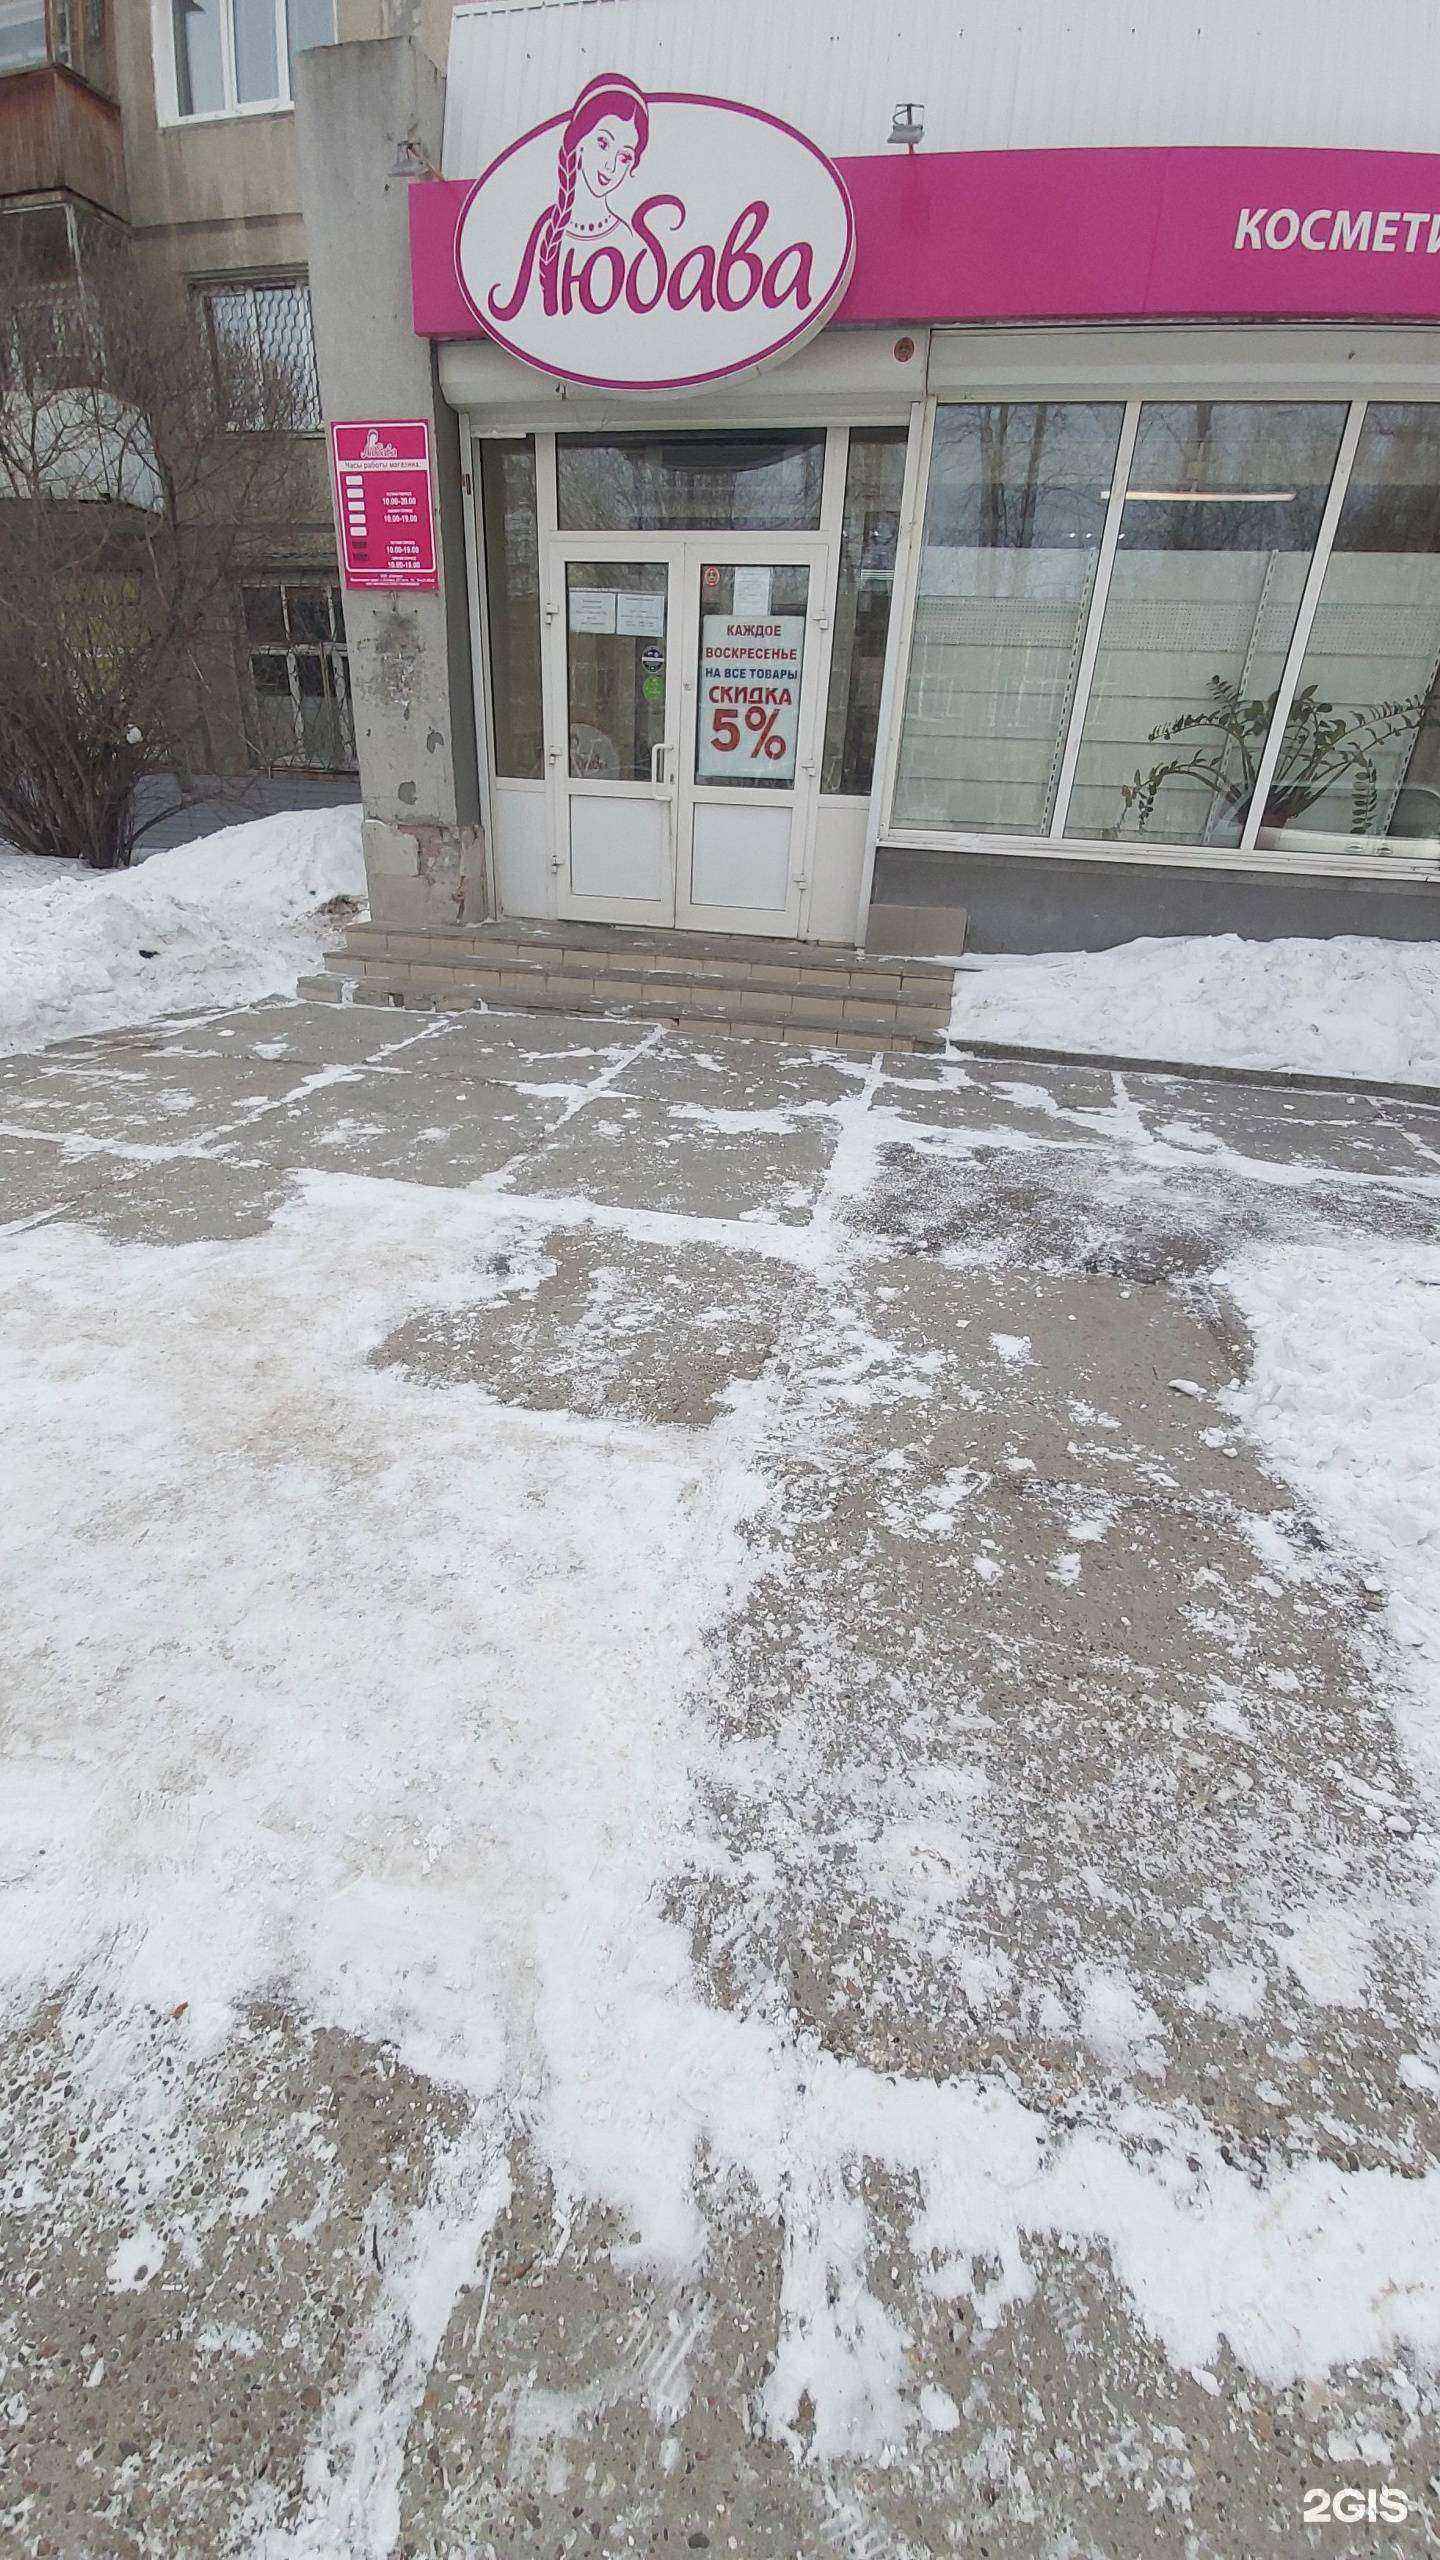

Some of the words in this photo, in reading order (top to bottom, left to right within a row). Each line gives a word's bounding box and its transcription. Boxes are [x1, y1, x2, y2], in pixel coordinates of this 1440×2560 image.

[488, 194, 813, 321] Любава
[726, 624, 782, 639] КАЖДОЕ
[705, 646, 798, 660] ВОСКРЕСЕНЬЕ
[705, 667, 721, 679] НА
[724, 668, 747, 679] ВСЕ
[750, 668, 798, 680] ТОВАРЫ
[708, 685, 792, 705] СКИДКА
[710, 705, 787, 761] 5%
